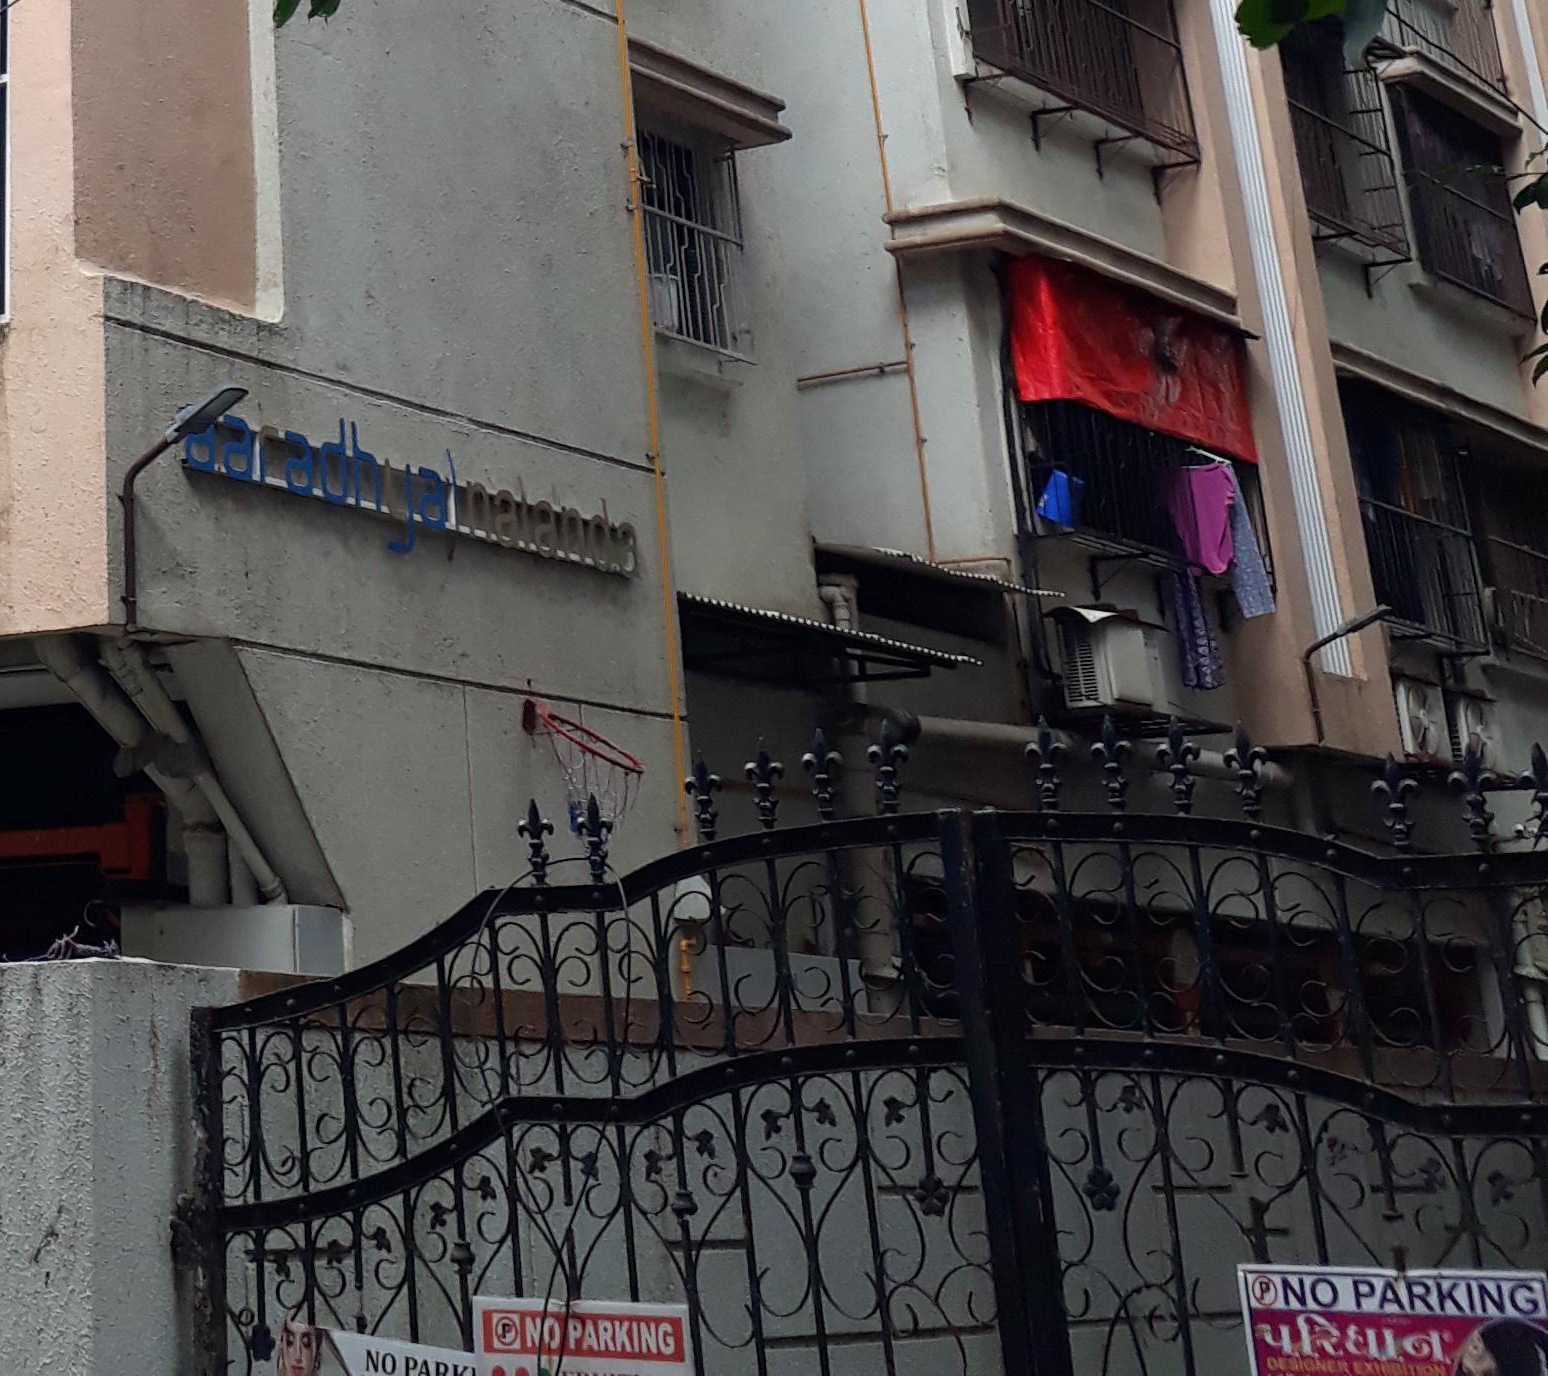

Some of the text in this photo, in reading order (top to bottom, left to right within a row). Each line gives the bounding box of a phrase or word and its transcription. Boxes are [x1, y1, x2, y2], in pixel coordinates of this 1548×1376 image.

[185, 415, 447, 554] aaradhya
[1281, 1277, 1540, 1315] NO PARKING
[524, 1316, 677, 1356] NO PARKING
[365, 1349, 397, 1375] NO
[1266, 1356, 1348, 1373] DESIGNER
